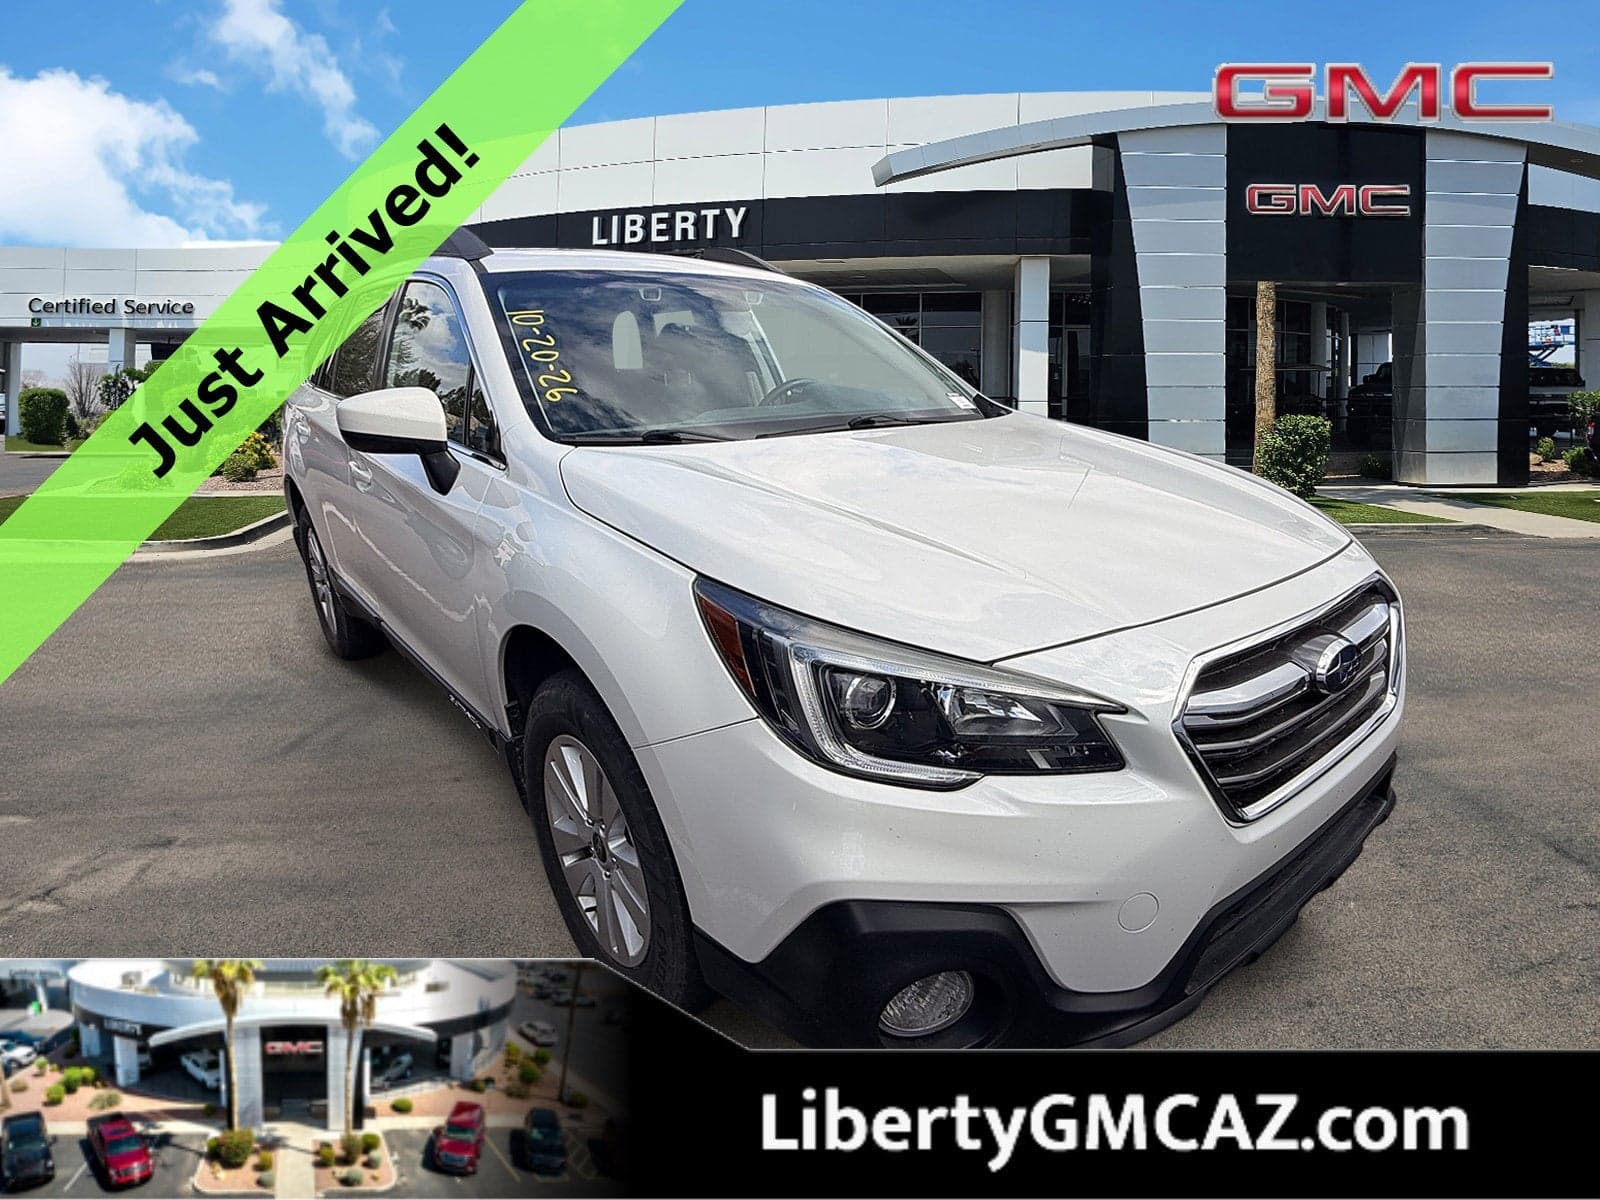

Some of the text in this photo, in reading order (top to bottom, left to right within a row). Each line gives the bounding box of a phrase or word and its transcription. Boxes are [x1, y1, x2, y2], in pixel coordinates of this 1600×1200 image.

[1246, 183, 1411, 217] GMC
[592, 206, 748, 245] LIBERTY
[28, 297, 194, 315] Certified Service
[506, 309, 578, 402] 10-20-26
